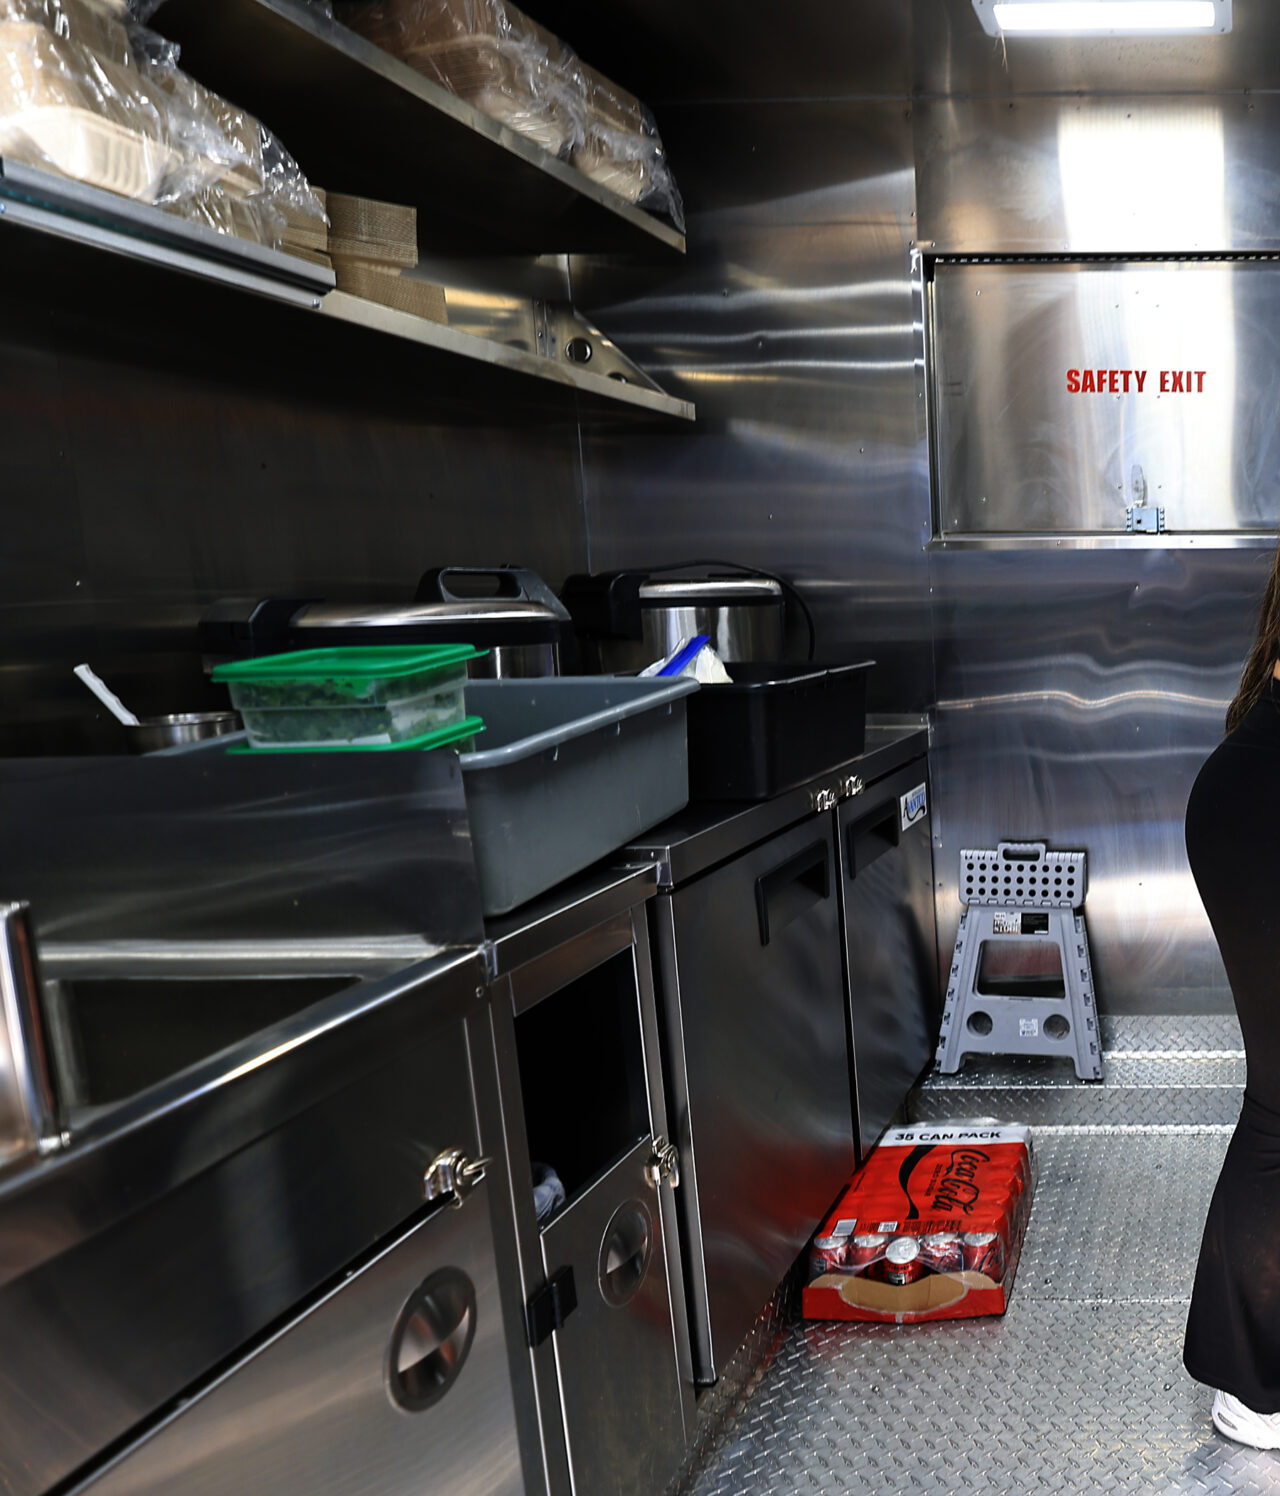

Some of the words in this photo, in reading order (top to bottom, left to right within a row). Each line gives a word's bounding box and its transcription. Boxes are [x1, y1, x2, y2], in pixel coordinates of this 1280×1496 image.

[1066, 368, 1147, 394] SAFETY
[1159, 370, 1207, 393] EXIT
[919, 1132, 954, 1140] CAN
[958, 1131, 1001, 1139] PACK
